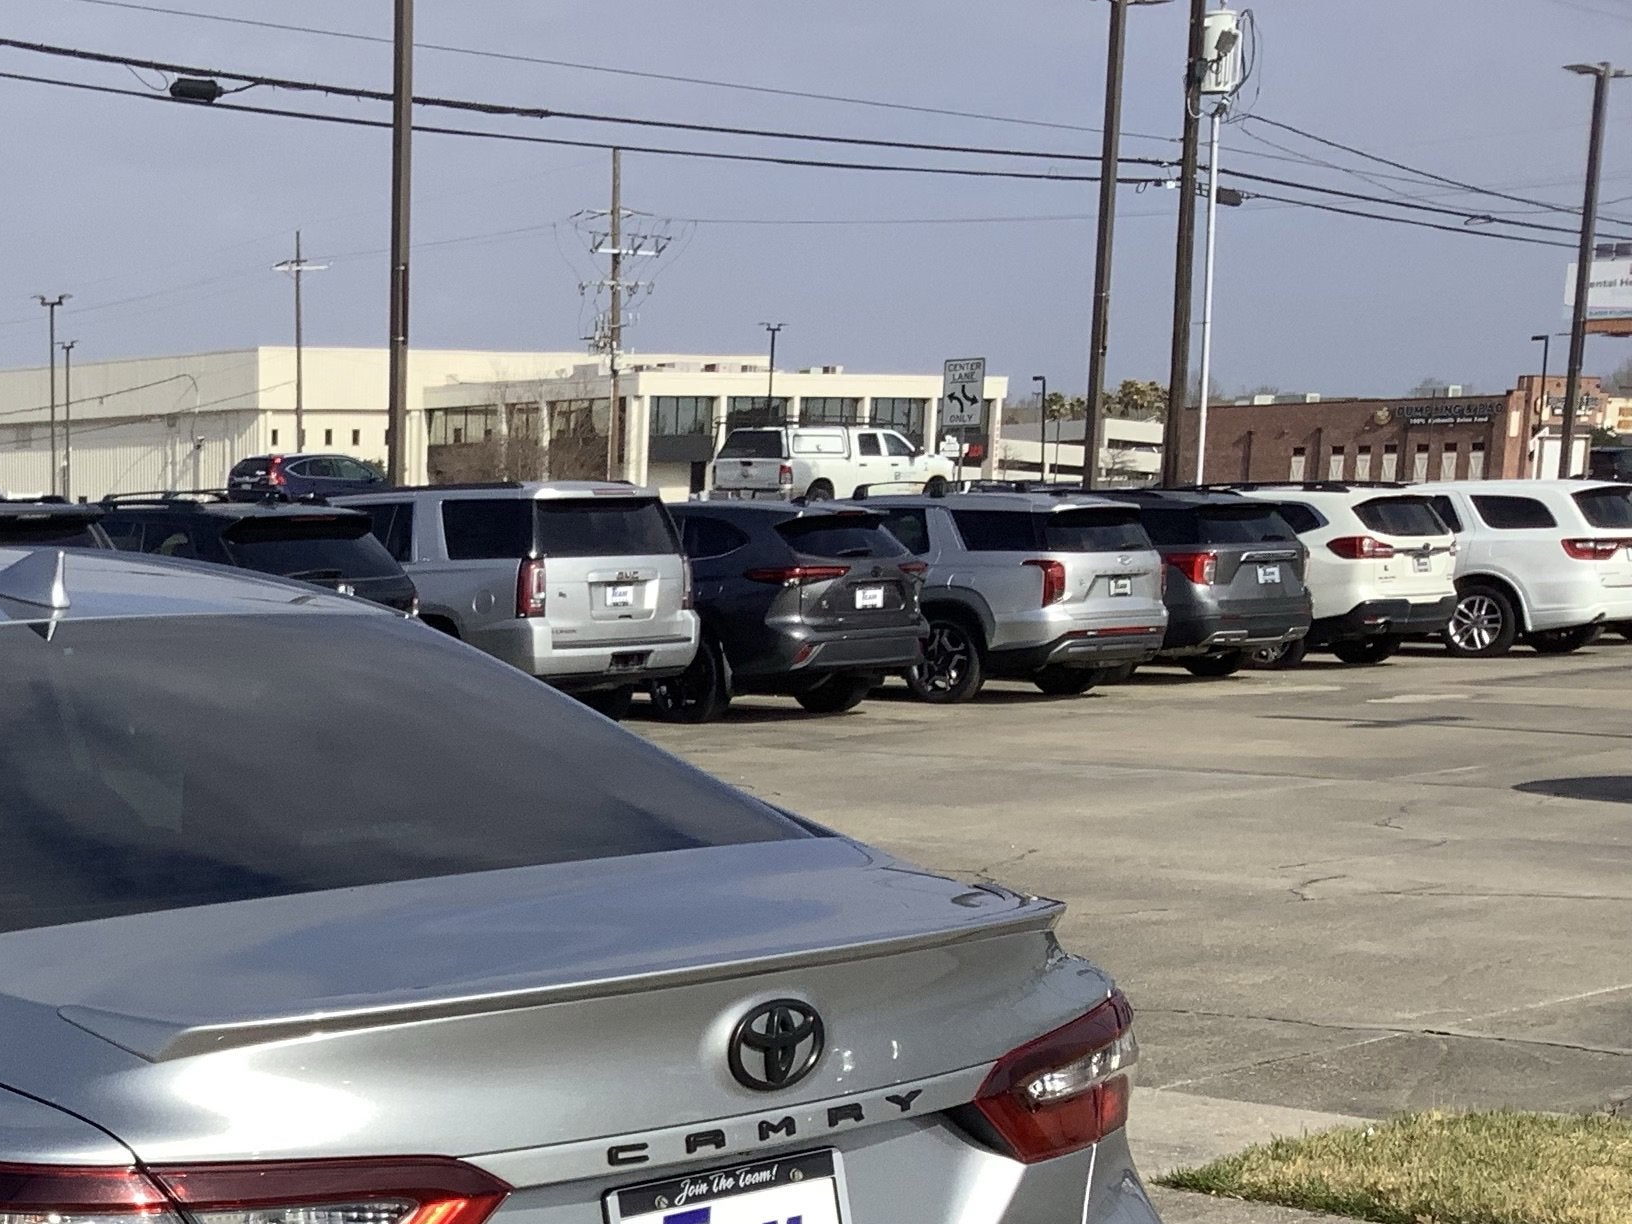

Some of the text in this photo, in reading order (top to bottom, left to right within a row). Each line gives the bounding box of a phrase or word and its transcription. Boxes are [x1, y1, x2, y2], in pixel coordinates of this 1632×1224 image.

[1588, 278, 1617, 289] ental
[948, 361, 982, 373] CENTER
[952, 371, 976, 381] LANE
[949, 413, 975, 424] ONLY
[607, 1089, 923, 1166] CAMRY
[674, 1163, 779, 1206] Join The Team!
